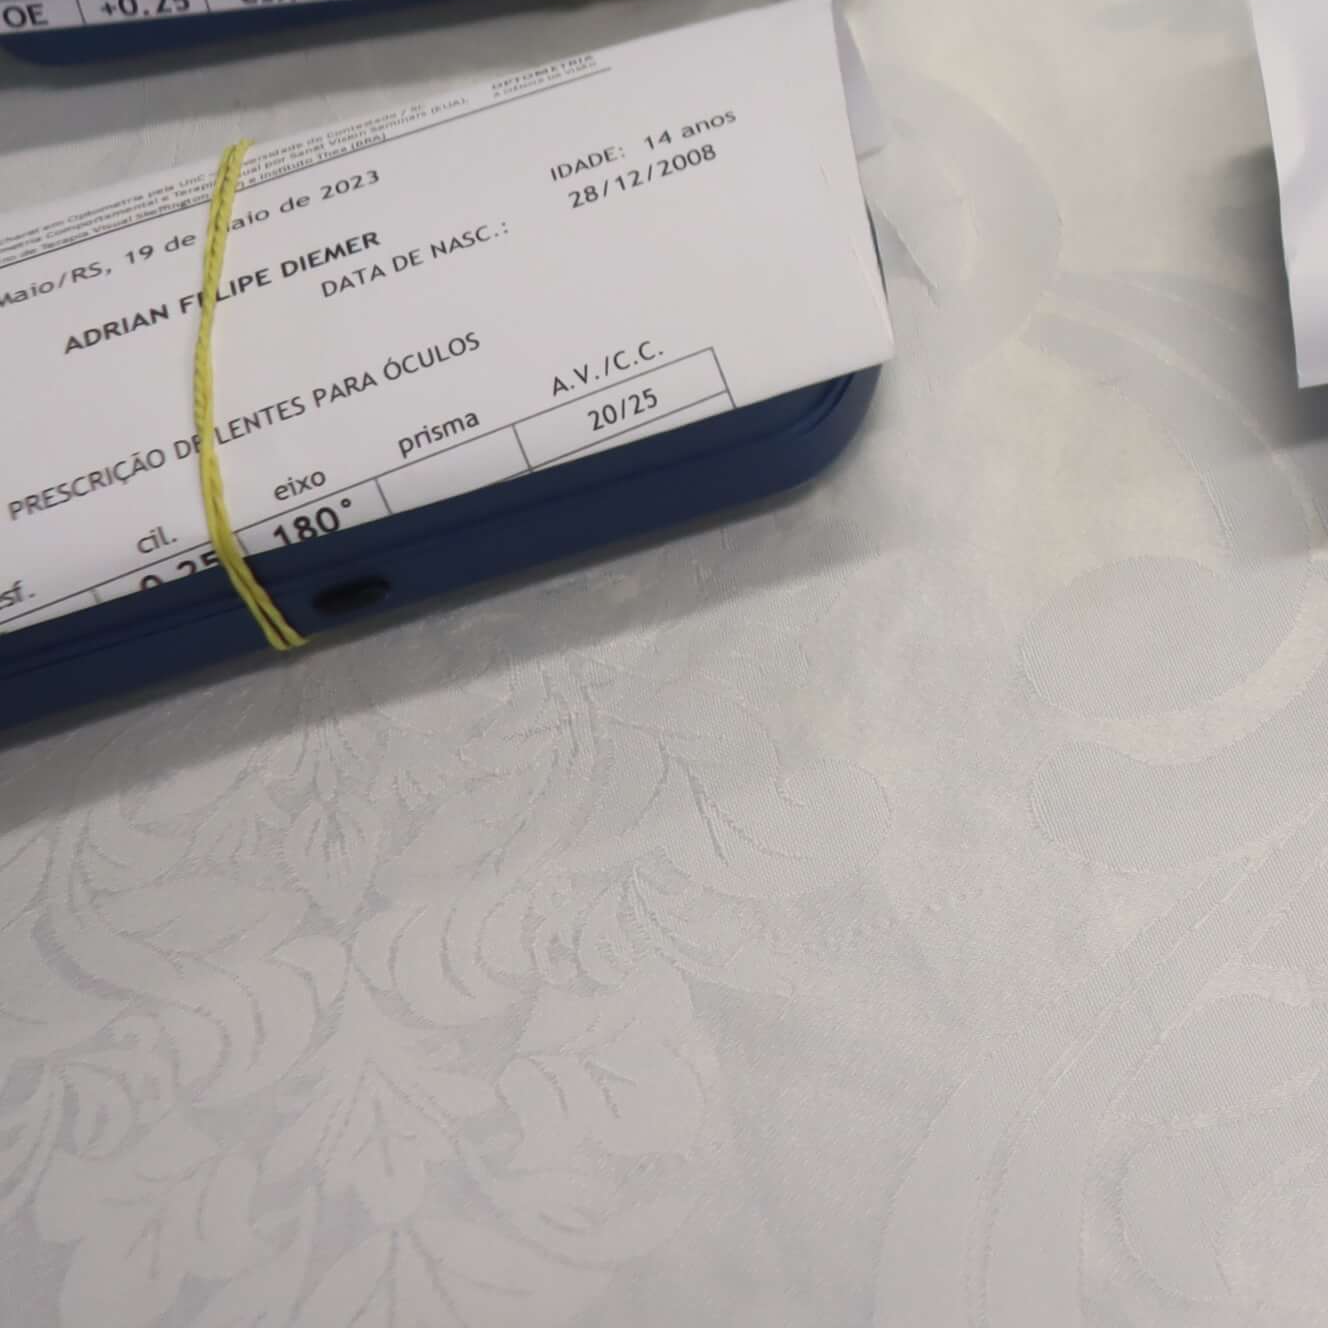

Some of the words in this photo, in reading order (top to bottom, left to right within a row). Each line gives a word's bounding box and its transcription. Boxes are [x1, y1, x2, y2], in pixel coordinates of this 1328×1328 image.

[3, 3, 49, 29] OE
[550, 145, 625, 181] IDADE:
[643, 130, 672, 151] 14
[681, 110, 736, 139] anos
[567, 143, 717, 209] 28/12/2008
[126, 245, 154, 265] 19
[164, 233, 197, 252] de
[224, 209, 270, 232] aio
[280, 194, 311, 213] de
[319, 170, 381, 200] 2023
[321, 264, 386, 298] DATA
[392, 251, 424, 273] DE
[430, 221, 509, 259] NASC.:
[64, 304, 169, 355] ADRIAN
[280, 231, 381, 279] DIEMER
[0, 580, 35, 608] sf.
[136, 525, 178, 556] cil.
[273, 471, 327, 501] eixo
[398, 409, 480, 459] prisma
[551, 339, 665, 396] A.V./C.C.
[8, 448, 166, 521] PRESCRIÇÃO
[174, 433, 203, 461] DE
[214, 396, 305, 445] LENTES
[312, 372, 377, 408] PARA
[382, 331, 481, 381] ÓCULOS
[273, 498, 352, 547] 180°
[587, 388, 659, 433] 20/25
